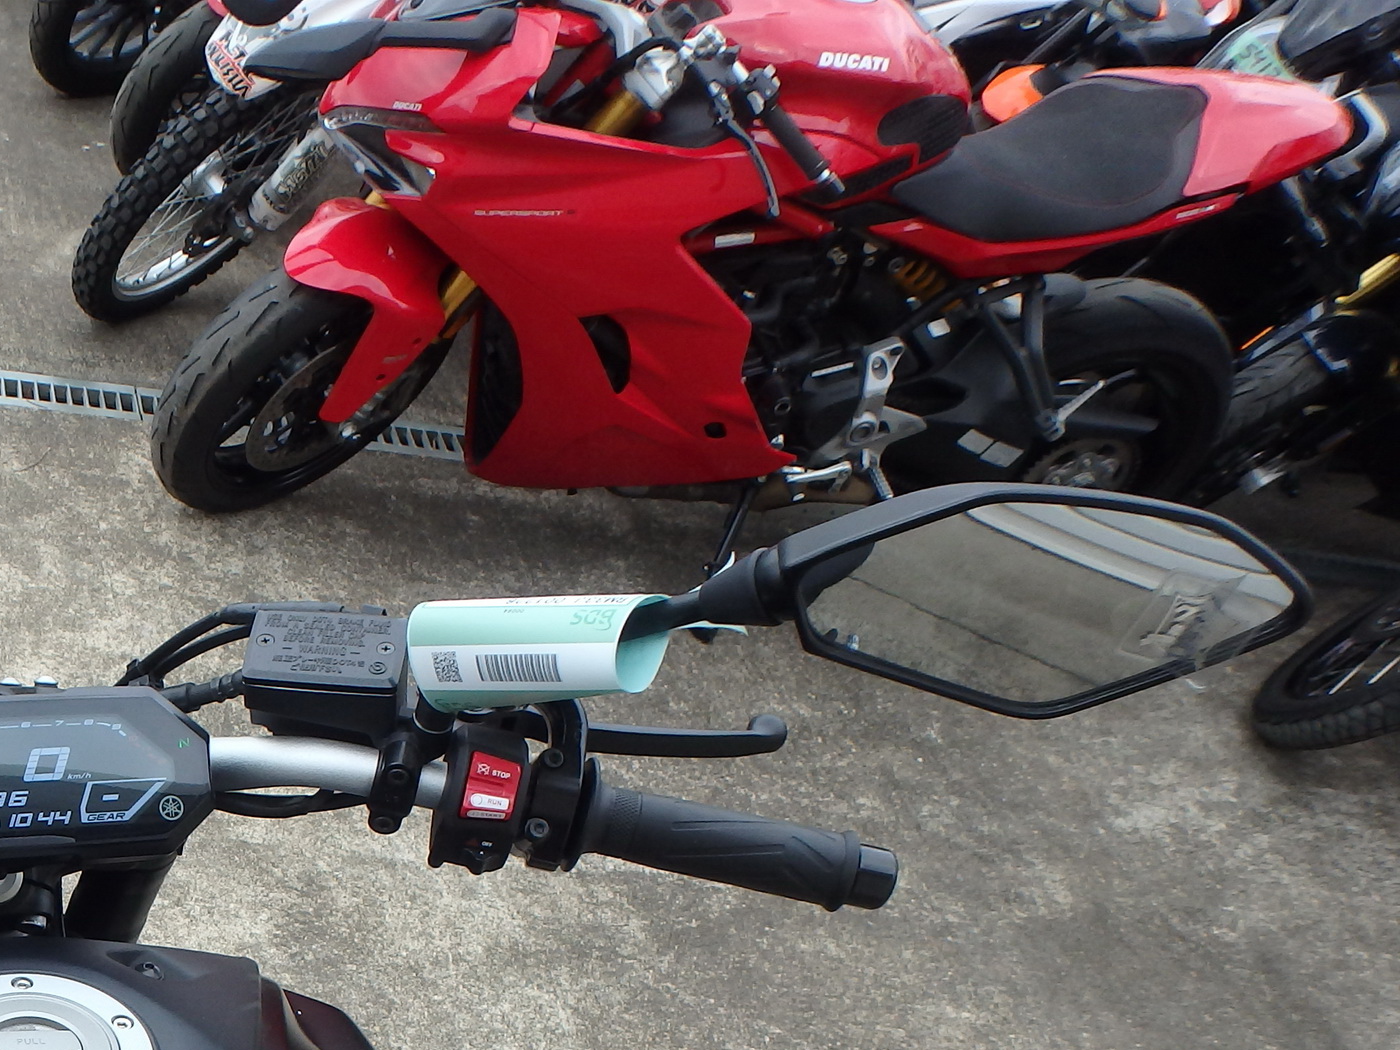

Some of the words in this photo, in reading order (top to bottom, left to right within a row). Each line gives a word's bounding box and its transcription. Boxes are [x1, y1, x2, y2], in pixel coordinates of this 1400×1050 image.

[818, 51, 890, 72] DUCATI
[392, 101, 422, 111] DUCATI
[23, 747, 70, 782] 0
[492, 770, 511, 779] STOP
[487, 798, 502, 806] RUN
[87, 813, 126, 821] GEAR
